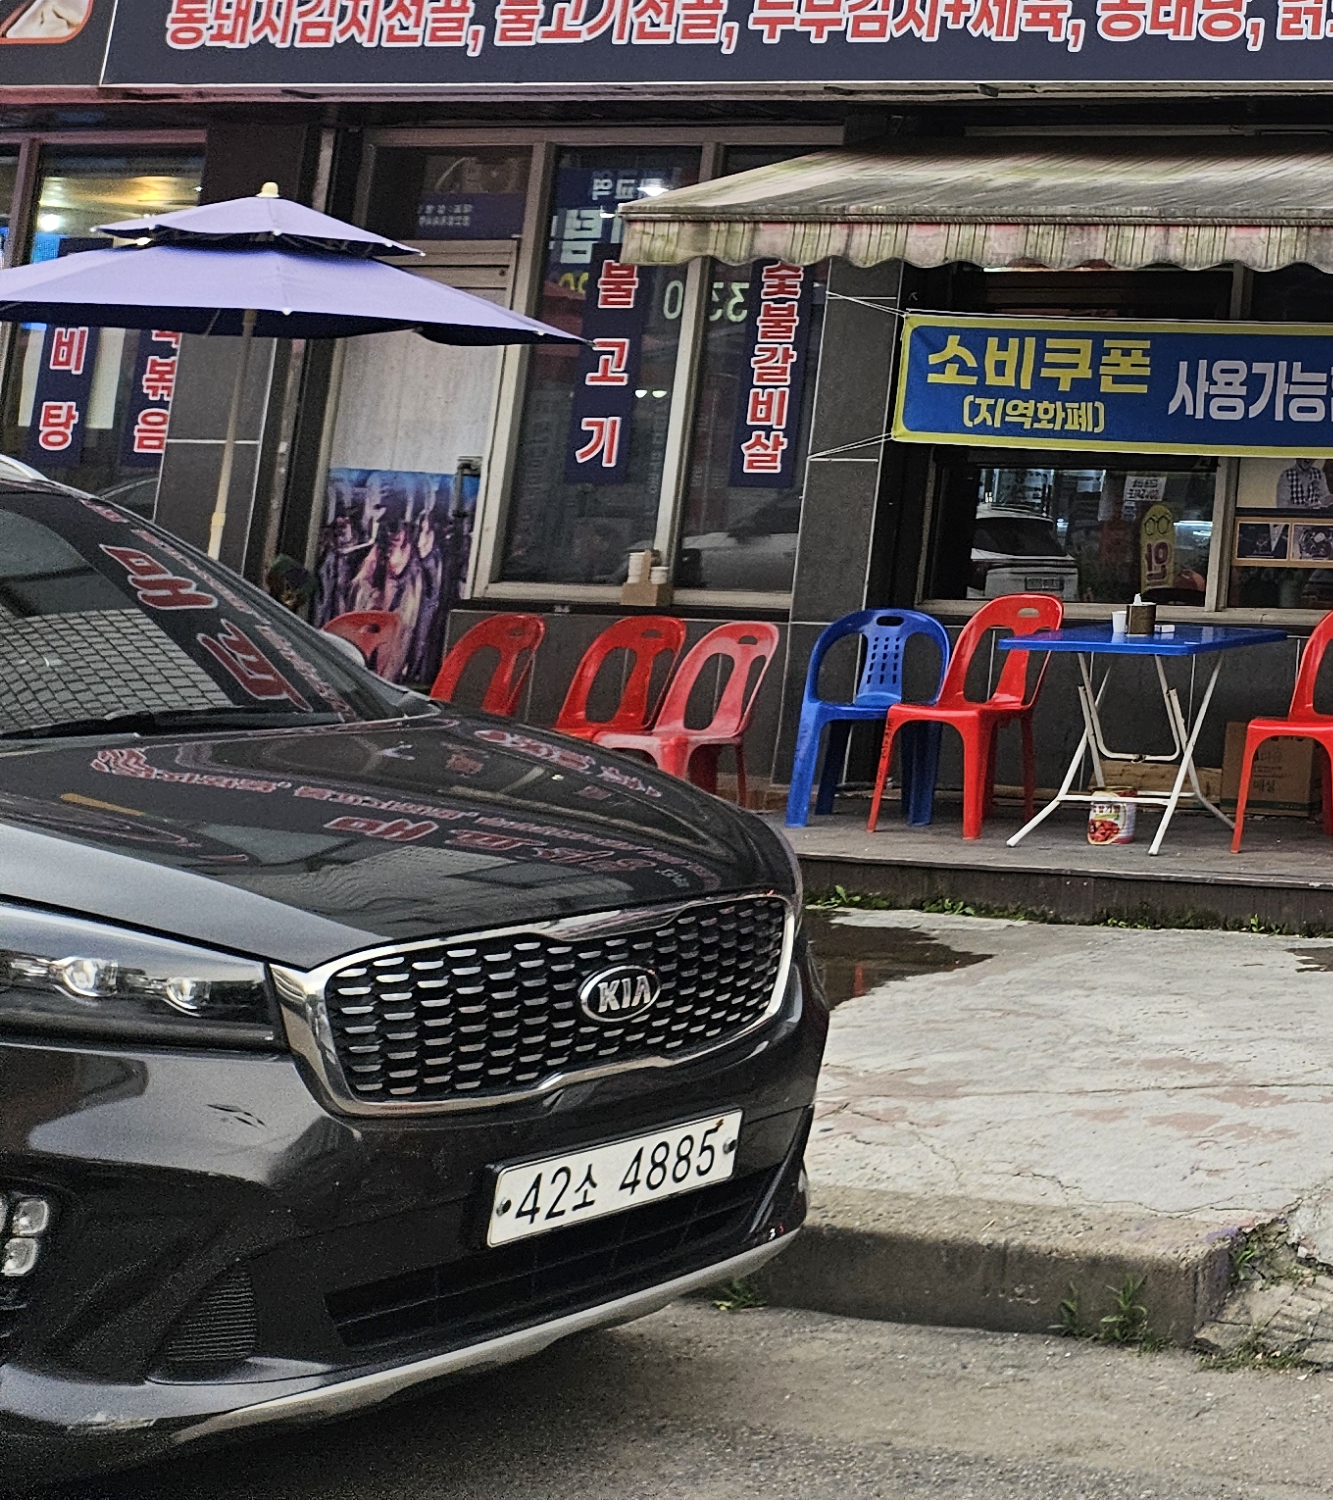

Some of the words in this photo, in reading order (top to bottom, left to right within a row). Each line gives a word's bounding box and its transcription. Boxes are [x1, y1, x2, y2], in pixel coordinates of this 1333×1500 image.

[575, 260, 639, 467] 불고기
[927, 334, 1152, 395] 소비쿠폰
[963, 397, 1106, 434] (지역화폐)
[597, 975, 652, 1014] KIA
[514, 1165, 599, 1226] 42소
[618, 1124, 718, 1197] 4885
